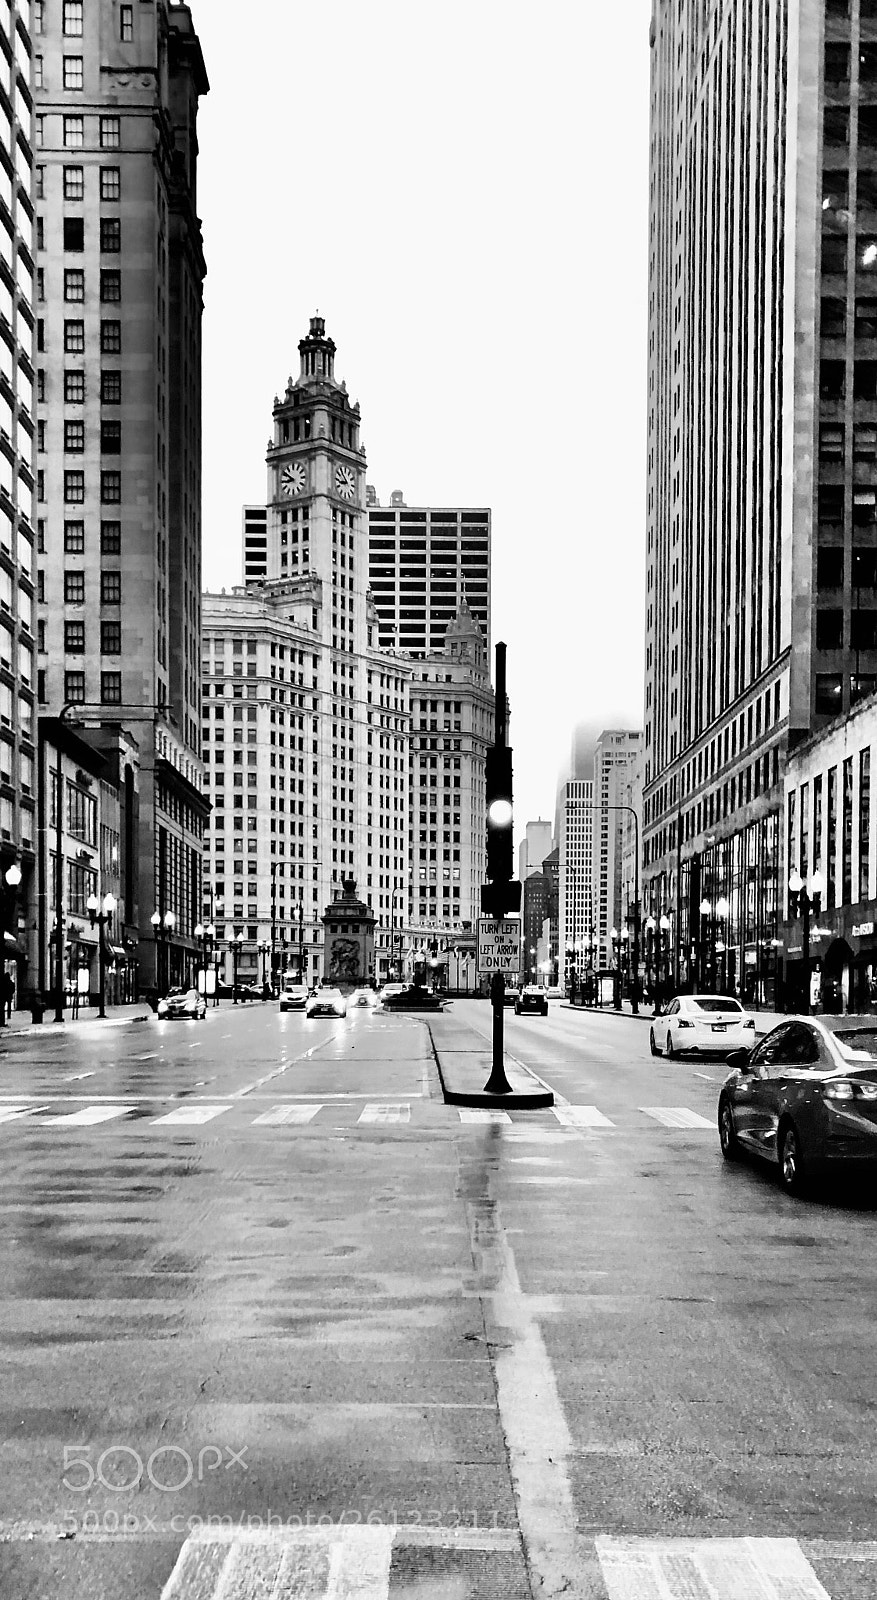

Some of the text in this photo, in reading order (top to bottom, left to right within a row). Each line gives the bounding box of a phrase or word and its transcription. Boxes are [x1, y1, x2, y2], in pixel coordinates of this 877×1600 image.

[481, 924, 518, 934] TURN LEFT
[494, 935, 505, 944] ON
[480, 945, 518, 954] LEFT ARROW
[486, 957, 511, 967] ONLY
